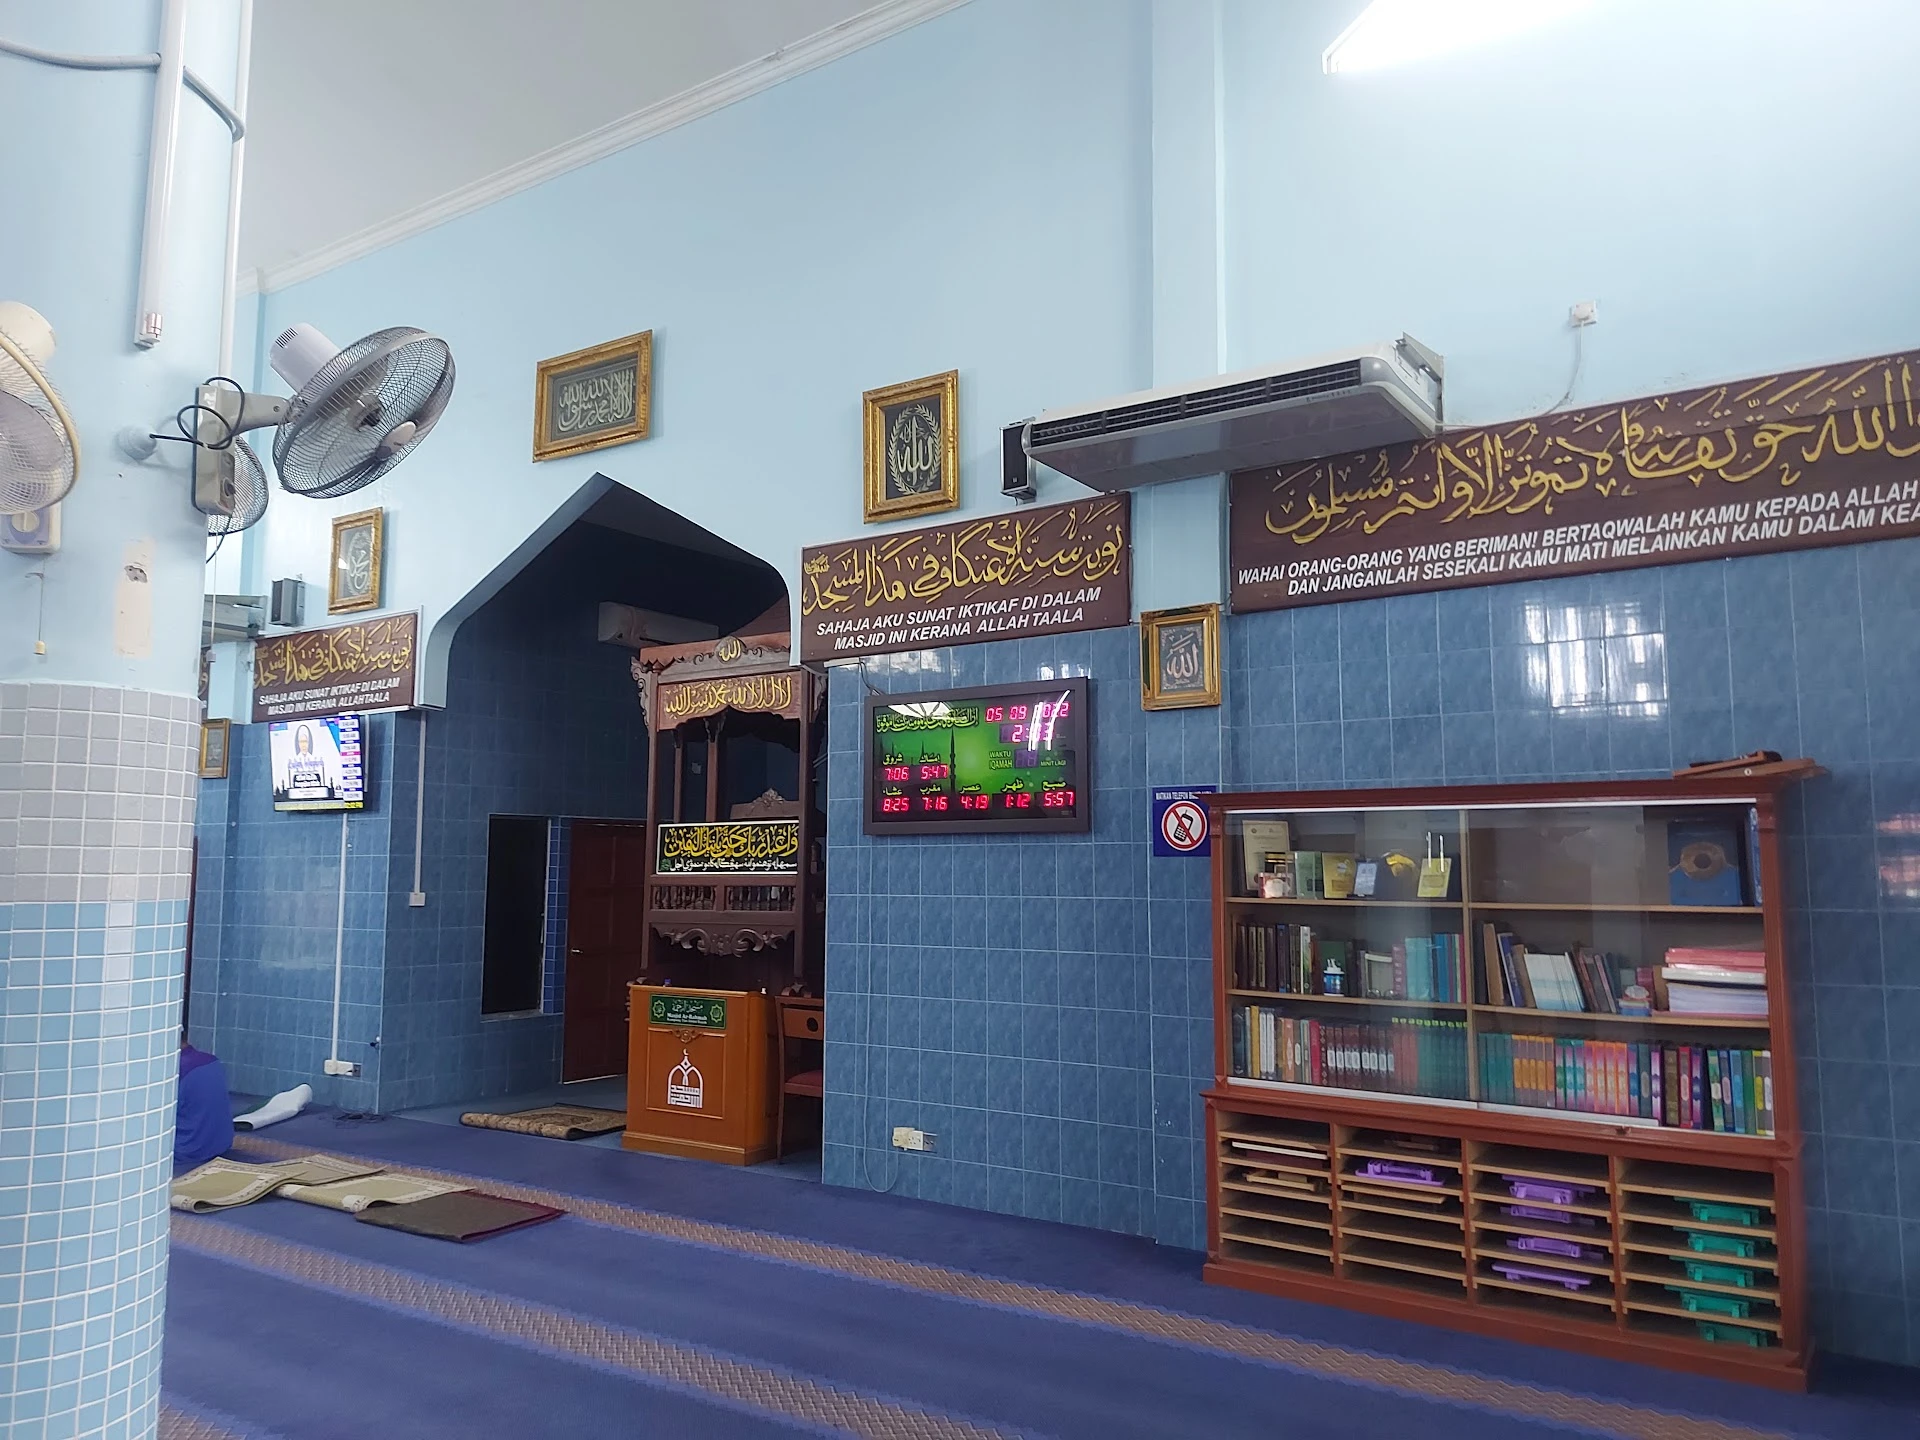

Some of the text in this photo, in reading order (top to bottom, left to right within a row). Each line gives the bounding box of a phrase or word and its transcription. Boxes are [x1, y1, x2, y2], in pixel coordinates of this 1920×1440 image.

[1237, 479, 1919, 585] WAHAI ORANG-ORANG YANG BERIMAN! BERTAQWALAH KAMU KEPADA ALLAH
[1287, 576, 1321, 597] DAN
[1322, 566, 1419, 593] JANGANLAH
[1421, 554, 1506, 583] SESEKALI
[1507, 546, 1562, 571] KAMU
[1563, 541, 1609, 563] MATI
[1611, 526, 1728, 559] MELAINKAN
[1730, 518, 1794, 543] KAMU
[1797, 507, 1877, 536] DALAM
[816, 586, 1102, 637] SAHAJA AKU SUNAT IKTIKAF DI DALAM
[833, 607, 1084, 651] MASJID INI KERANA ALLAH TAALA
[288, 690, 305, 702] AKU
[304, 687, 331, 700] SUNAT
[330, 682, 362, 697] IKTIKAF
[361, 680, 371, 692] DI
[371, 677, 400, 691] DALAM
[267, 691, 390, 716] MASJID INI KERANA ALLAH TAALA
[986, 707, 1003, 722] 05
[1010, 706, 1028, 720] 09
[989, 750, 1012, 758] WAKTU
[921, 764, 949, 780] 5:47
[989, 759, 1013, 770] IQAMAH
[885, 766, 909, 781] 7:06
[960, 784, 981, 794] عصر
[1002, 779, 1024, 792] ظهر
[1042, 781, 1067, 791] صبح
[883, 797, 910, 812] 8:25
[1005, 793, 1031, 808] 1:12
[1044, 791, 1074, 807] 5:57
